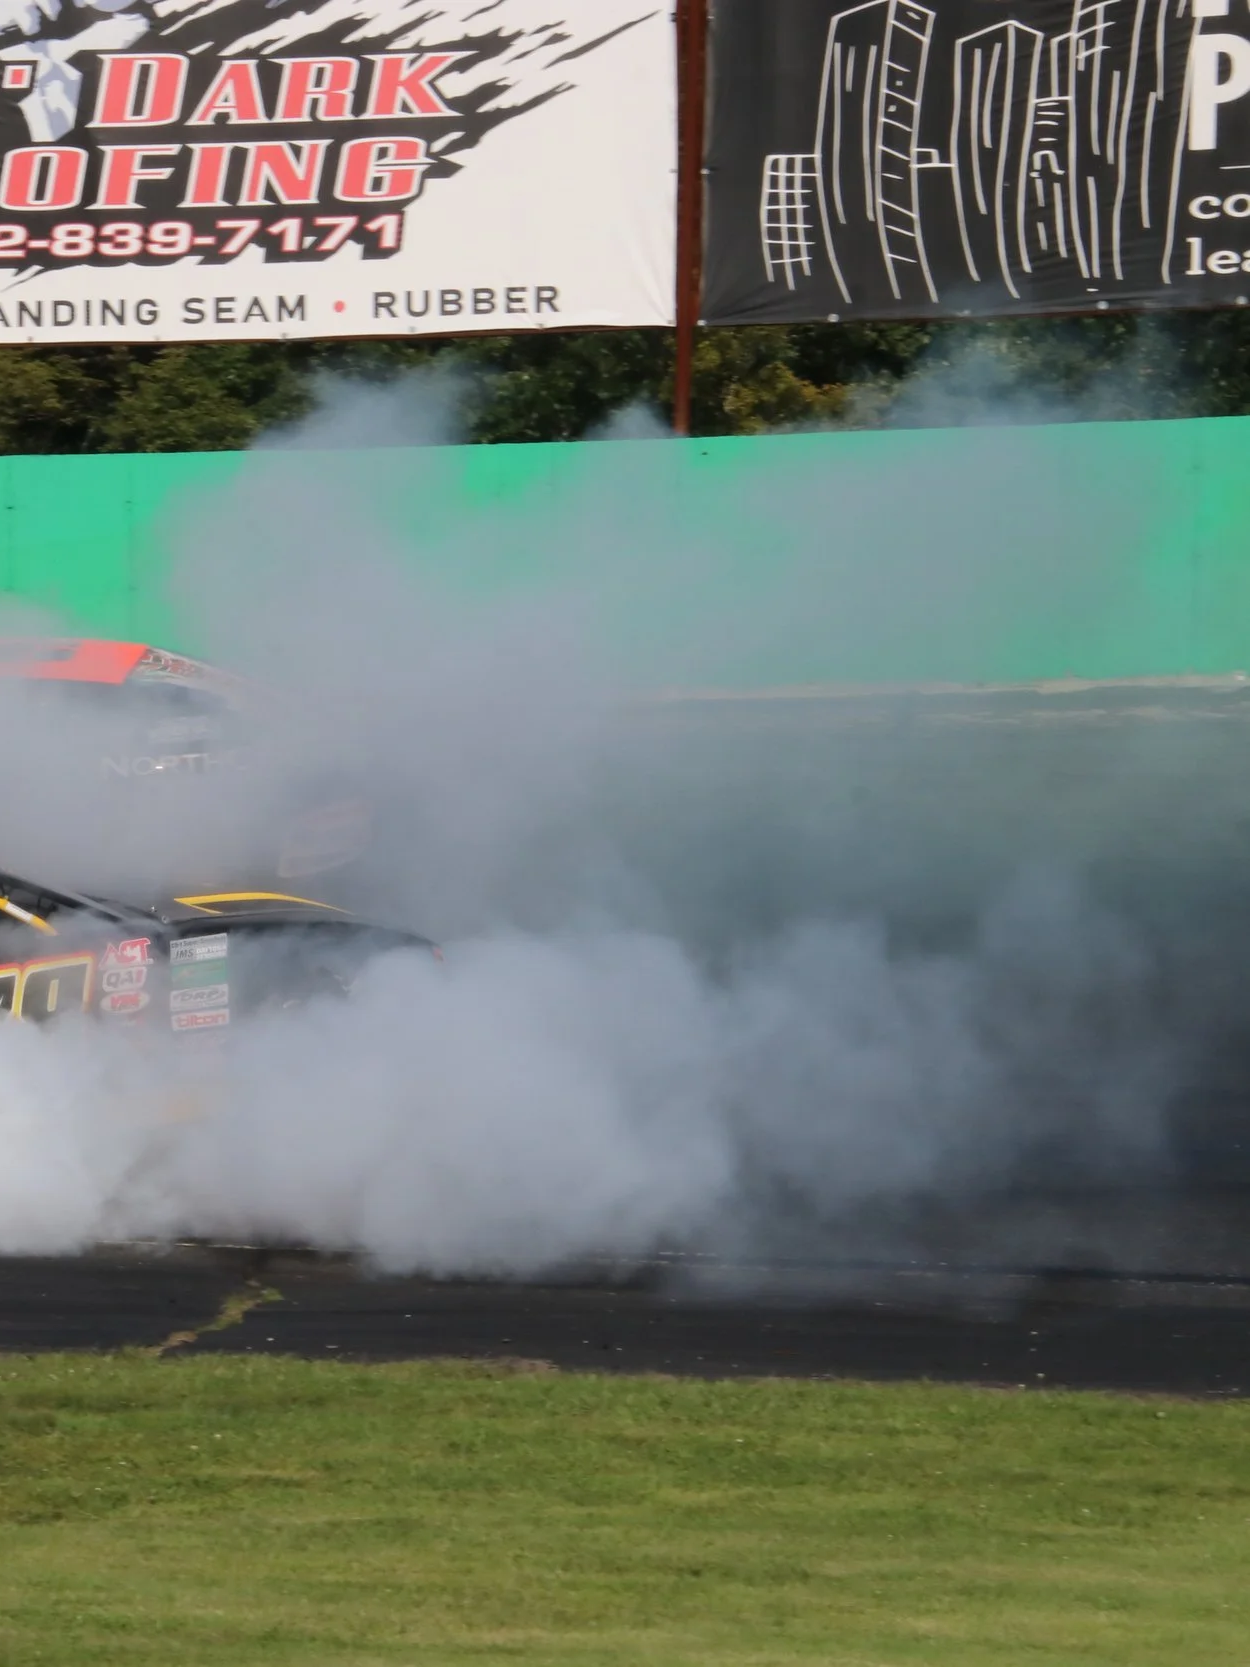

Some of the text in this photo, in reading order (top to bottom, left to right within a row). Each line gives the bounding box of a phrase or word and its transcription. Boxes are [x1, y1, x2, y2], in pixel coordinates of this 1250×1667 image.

[86, 50, 480, 128] DARK
[181, 295, 307, 324] SEAM
[372, 286, 561, 320] RUBBER
